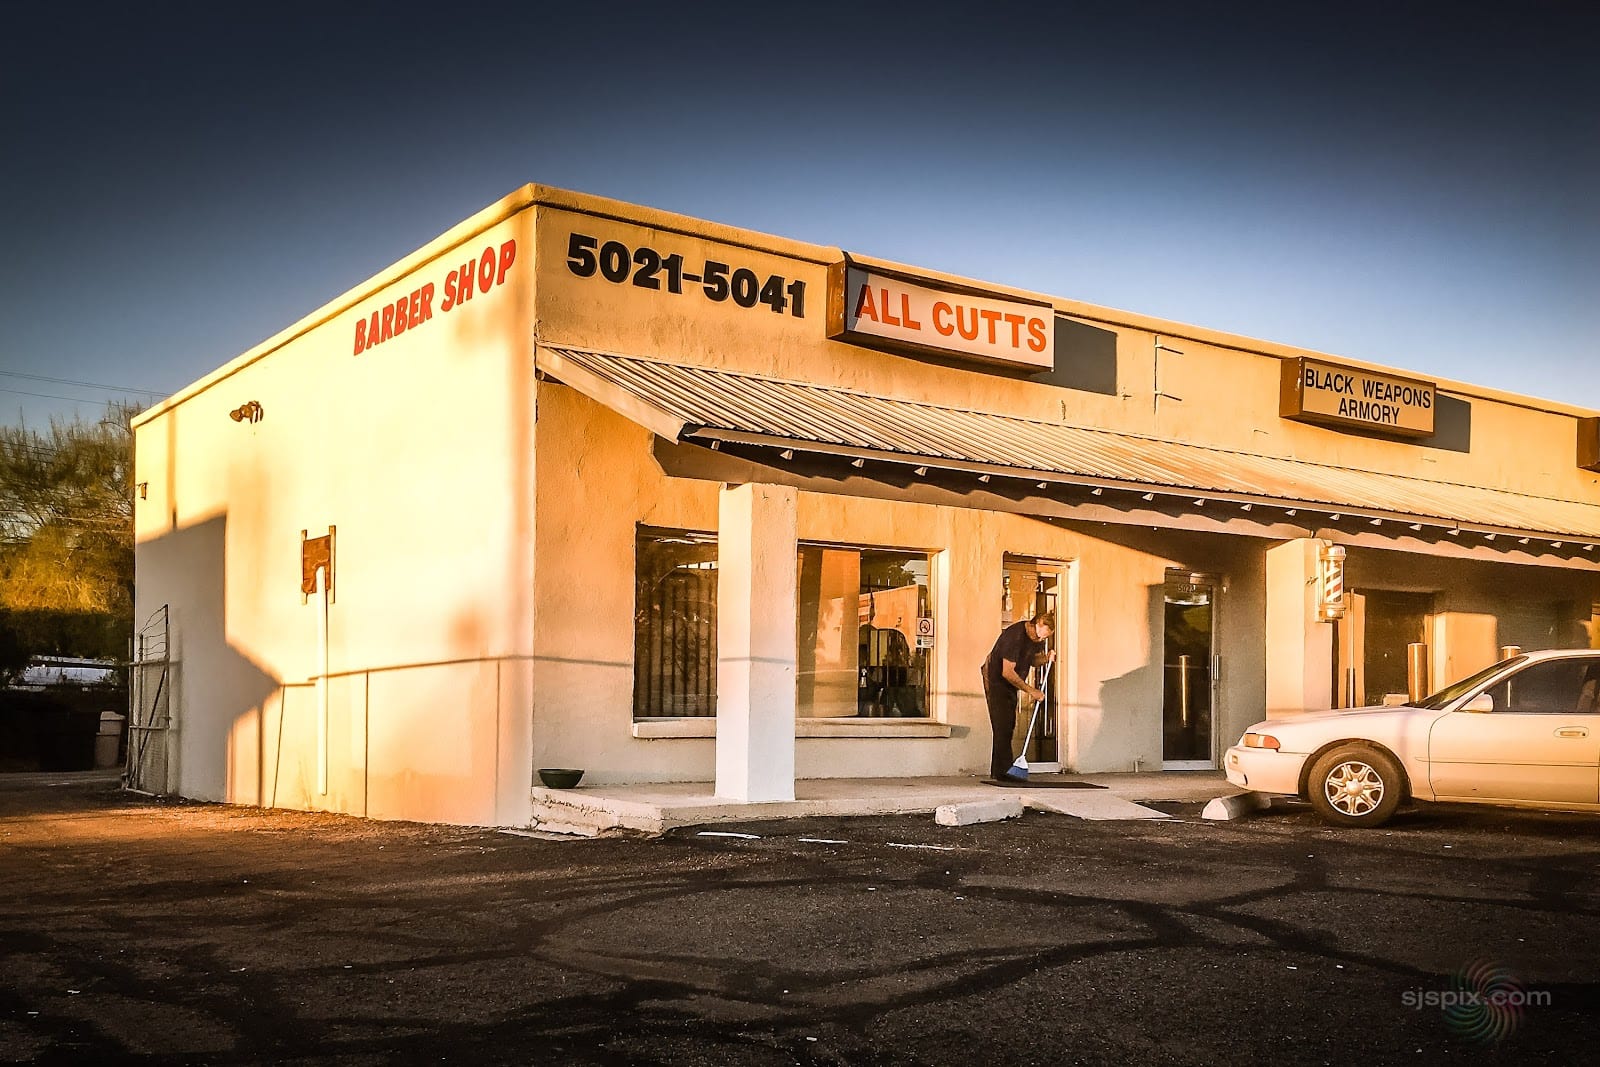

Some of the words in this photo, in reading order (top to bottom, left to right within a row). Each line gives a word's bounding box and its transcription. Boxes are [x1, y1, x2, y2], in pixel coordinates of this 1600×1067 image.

[354, 283, 433, 355] BARBER
[441, 239, 516, 312] SHOP
[568, 233, 806, 318] 5021-5041
[855, 284, 921, 330] ALL
[932, 301, 1047, 353] CUTTS
[1305, 368, 1354, 395] BLACK
[1362, 380, 1431, 408] WEAPONS
[1338, 398, 1400, 424] ARMORY
